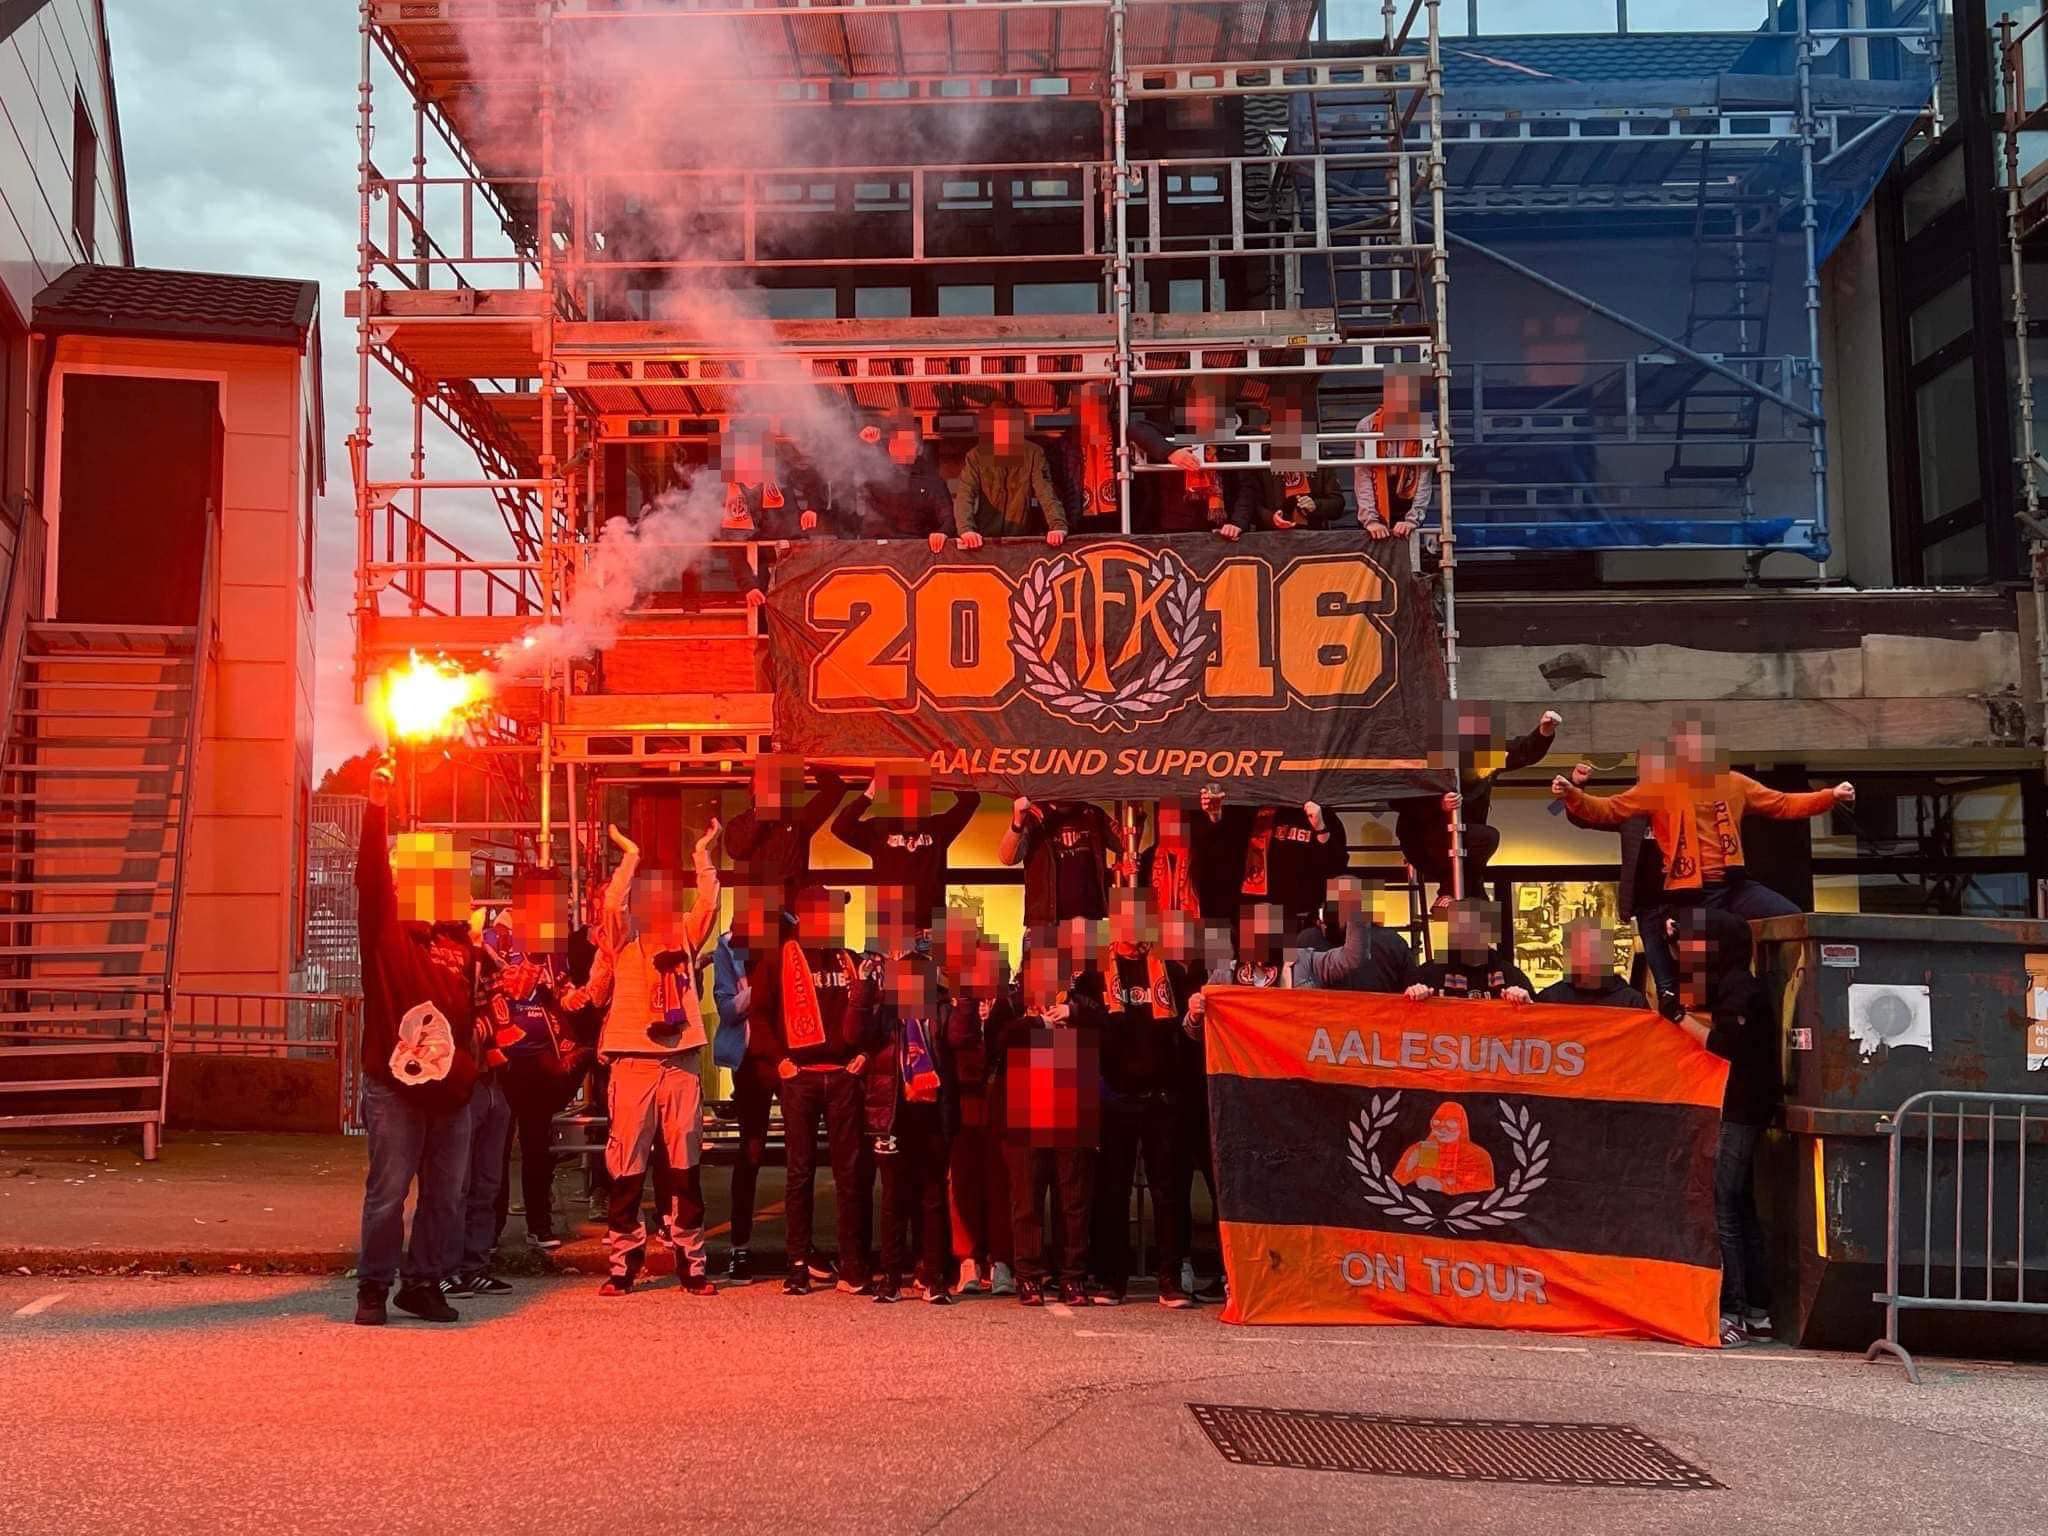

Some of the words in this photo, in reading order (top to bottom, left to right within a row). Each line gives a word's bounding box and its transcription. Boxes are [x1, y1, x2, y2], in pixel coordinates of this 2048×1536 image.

[930, 749, 1108, 776] AALESUND
[1115, 749, 1283, 778] SUPPORT
[1307, 1028, 1586, 1077] AALESUNDS
[1341, 1251, 1406, 1293] ON
[1423, 1257, 1548, 1305] TOUR
